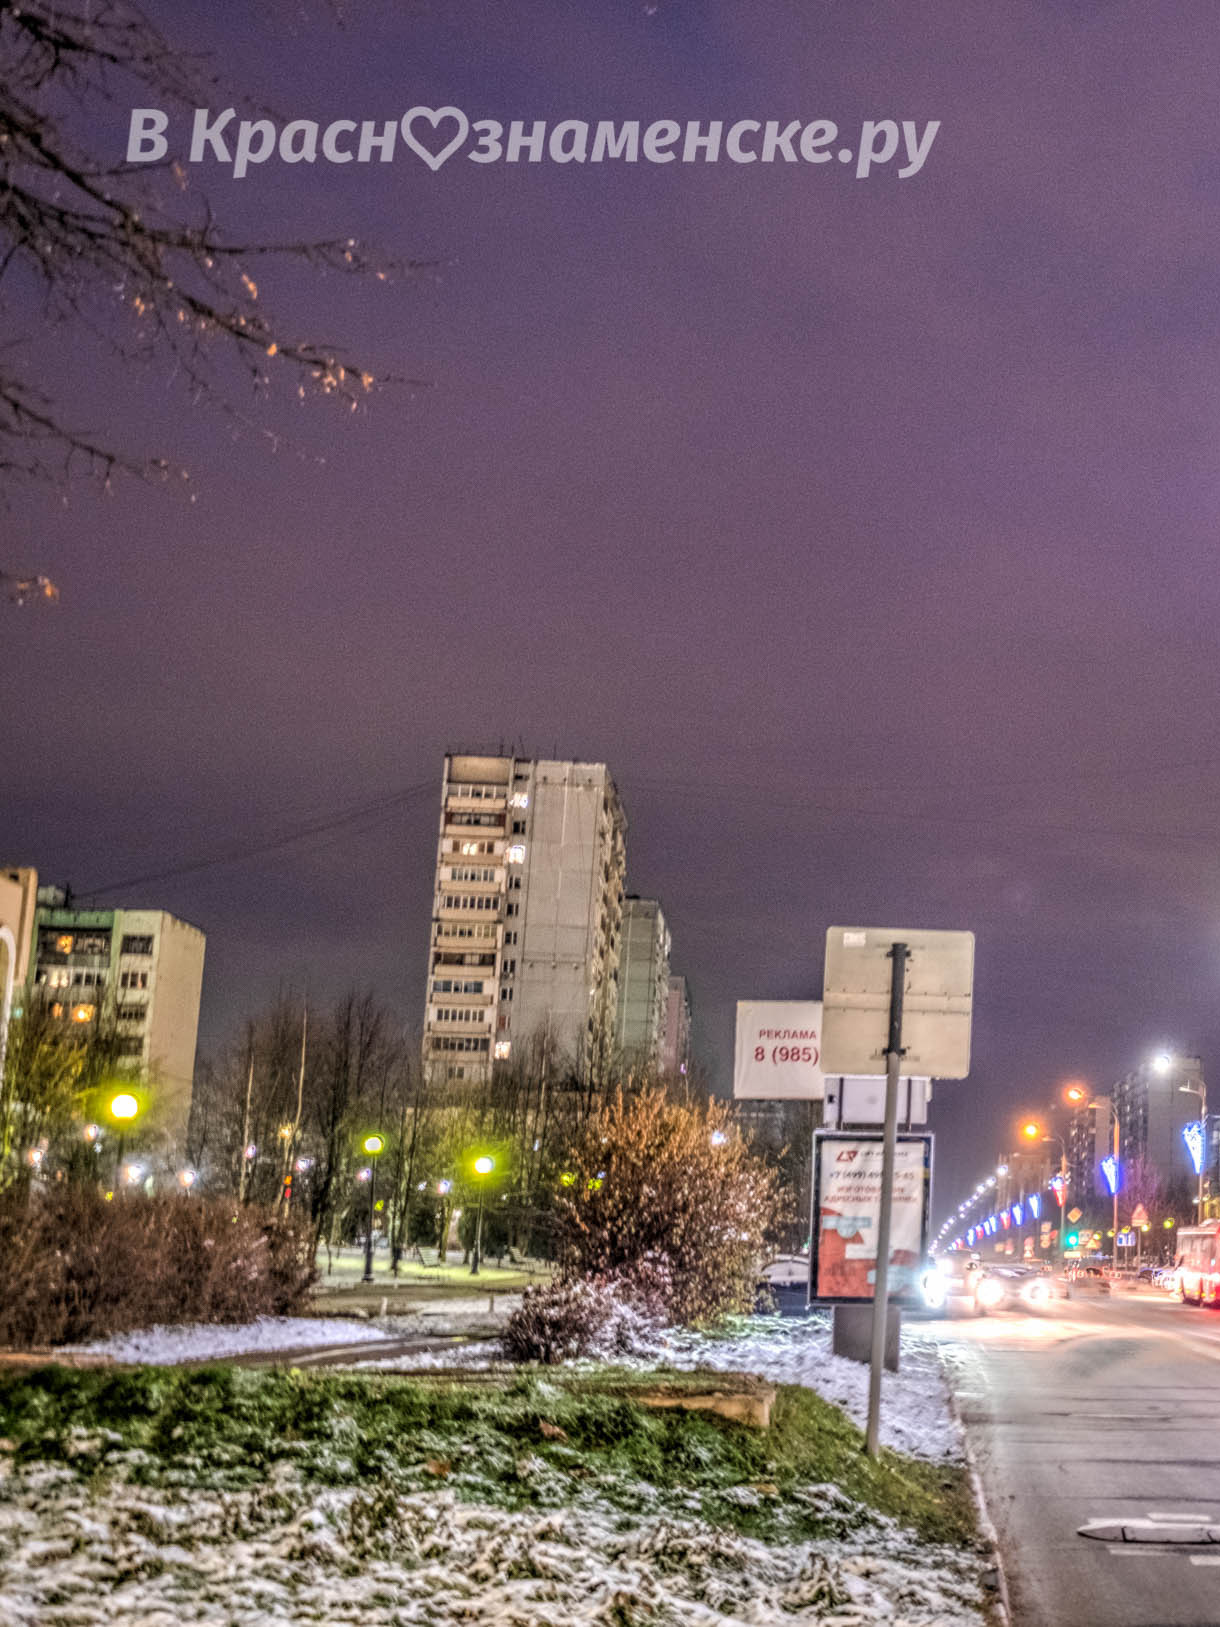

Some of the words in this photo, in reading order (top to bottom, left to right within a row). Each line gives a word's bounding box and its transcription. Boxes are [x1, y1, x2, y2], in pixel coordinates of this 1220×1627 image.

[759, 1029, 817, 1039] РЕКЛАМА
[754, 1046, 765, 1062] 8
[772, 1045, 819, 1066] (985)
